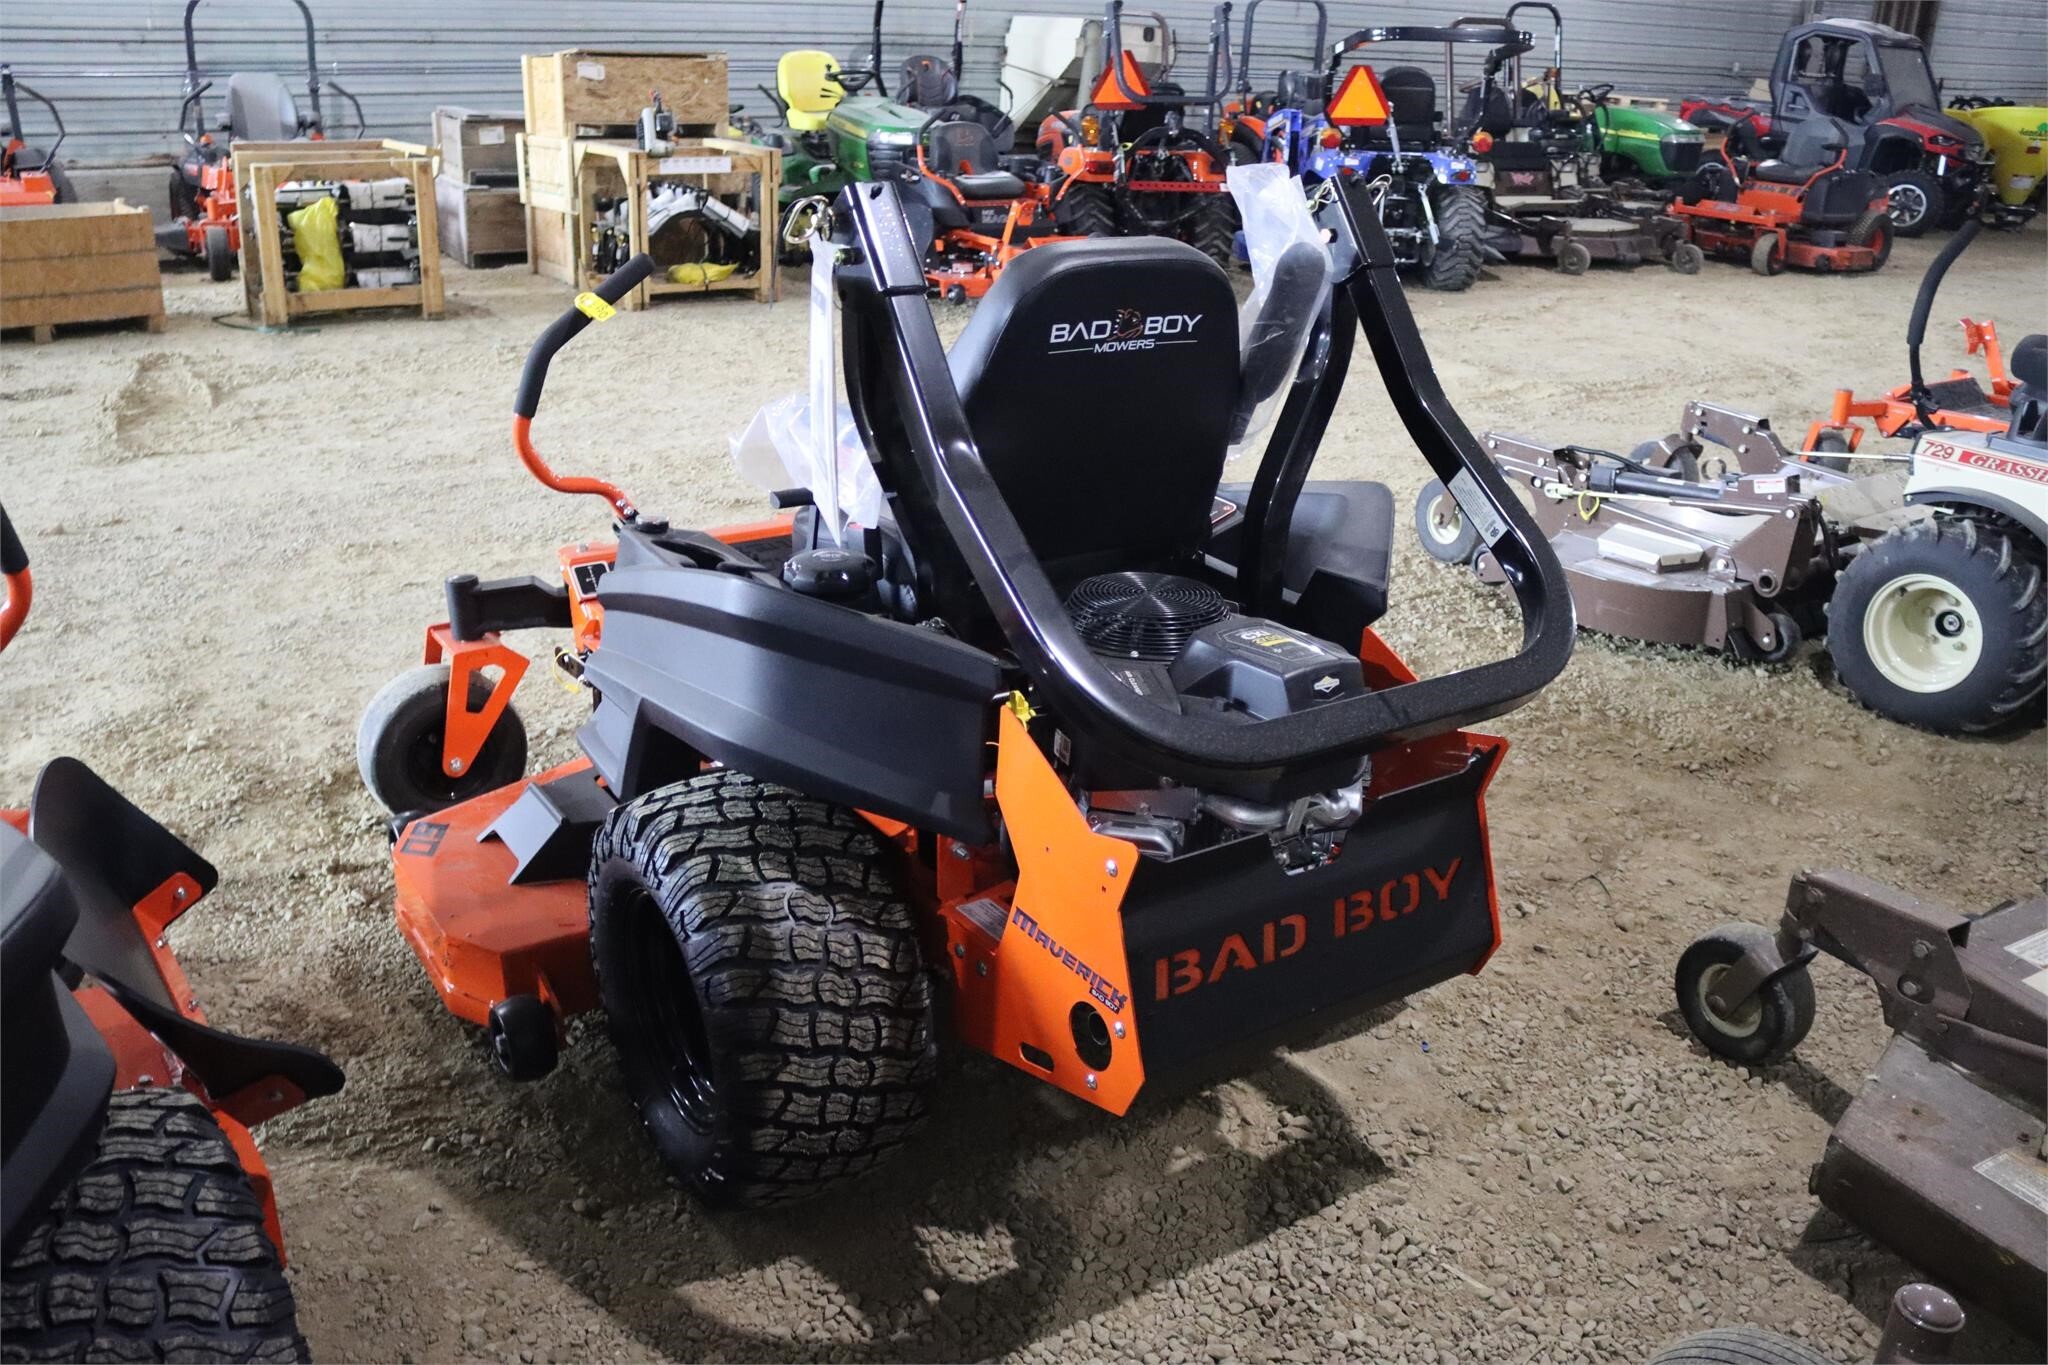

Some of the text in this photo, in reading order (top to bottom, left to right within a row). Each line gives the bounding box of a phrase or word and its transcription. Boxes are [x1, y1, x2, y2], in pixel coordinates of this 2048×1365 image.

[1049, 313, 1203, 344] BAD BOY
[1093, 338, 1156, 354] MOWERS
[1922, 440, 1956, 460] 729
[1155, 856, 1463, 1001] BAD BOY
[1012, 905, 1128, 1010] MAVERICK
[1091, 988, 1118, 1012] BAD BOY
